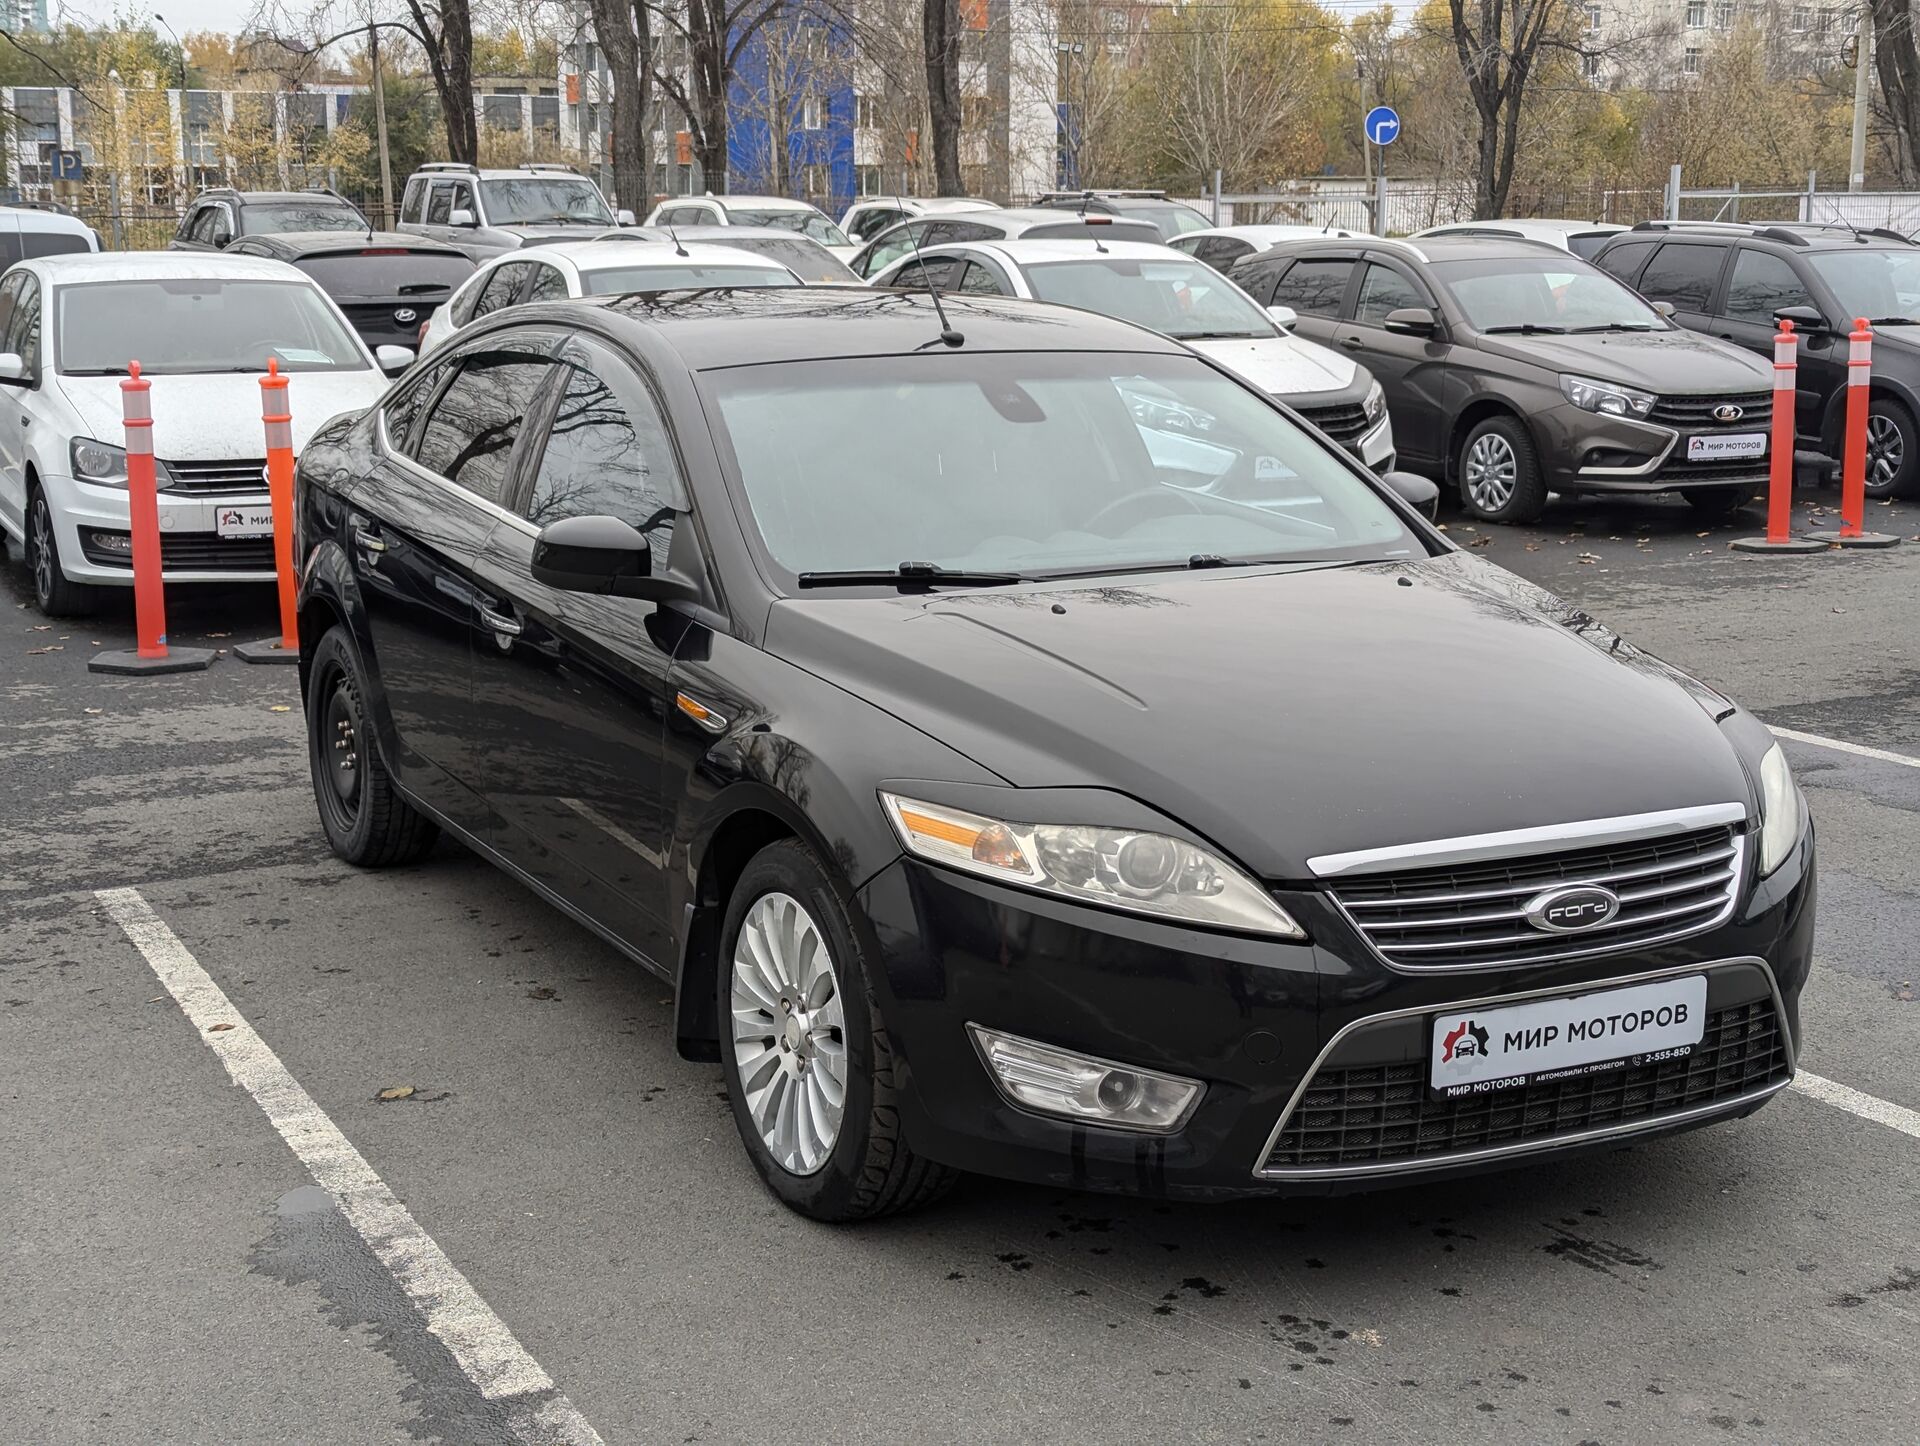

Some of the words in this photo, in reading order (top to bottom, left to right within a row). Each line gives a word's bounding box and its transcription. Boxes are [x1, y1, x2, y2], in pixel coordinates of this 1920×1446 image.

[59, 153, 76, 177] P
[1707, 443, 1724, 451] МИР
[1726, 441, 1761, 450] МОТОРОВ
[1503, 1025, 1559, 1053] МИР
[1567, 1003, 1689, 1043] МОТОРОВ
[1447, 1085, 1471, 1097] МИР
[1473, 1076, 1526, 1093] МОТОРОВ
[1536, 1067, 1583, 1082] АВТОМОБИЛИ
[1583, 1066, 1589, 1074] С
[1589, 1060, 1625, 1073] ПРОБЕГОМ
[1645, 1046, 1691, 1063] 2-555-850
